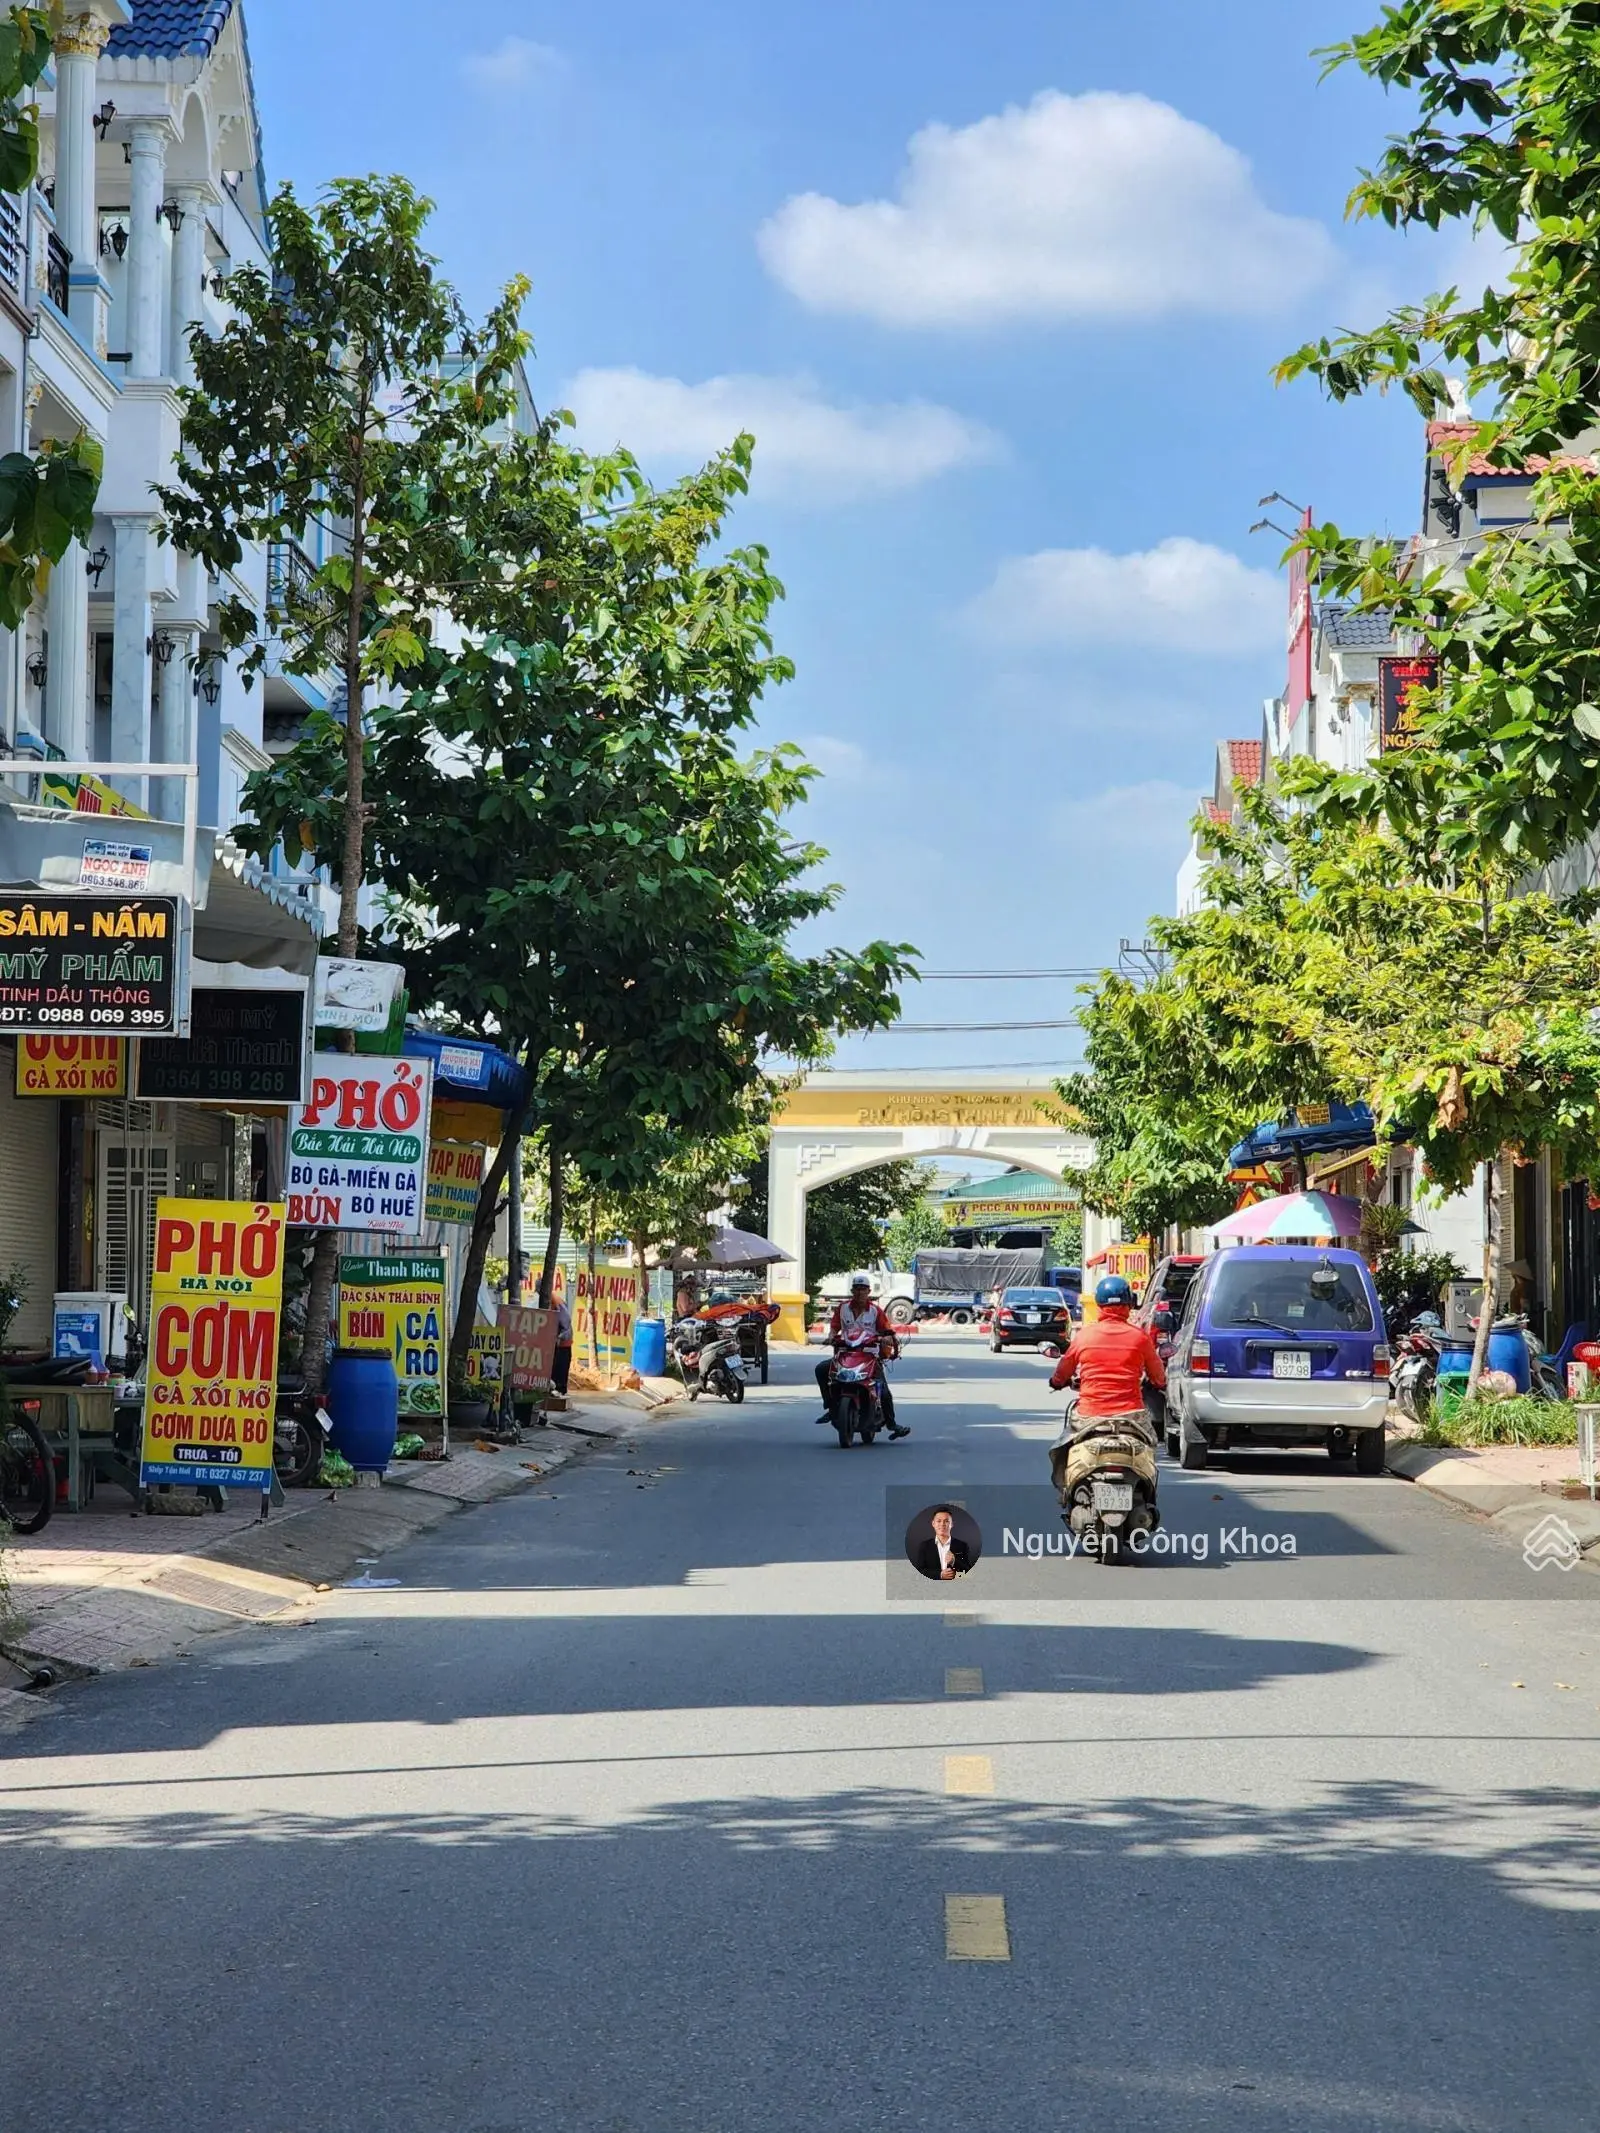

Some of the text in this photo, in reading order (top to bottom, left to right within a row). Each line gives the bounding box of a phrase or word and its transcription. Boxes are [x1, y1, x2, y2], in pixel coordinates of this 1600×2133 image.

[121, 862, 148, 877] ANH
[0, 902, 167, 939] SÂM - NẤM
[0, 941, 164, 982] MỸ PHẨM
[0, 986, 40, 1003] TINH
[89, 985, 152, 1005] THÔNG
[0, 1007, 166, 1025] ĐT: 0988 069 395
[226, 1036, 294, 1066] Thanh
[25, 1060, 118, 1090] GÀ XỐI MỠ
[154, 1068, 286, 1093] 0364 398 268
[300, 1062, 424, 1132] PHỞ
[295, 1132, 323, 1152] Bắc
[291, 1161, 417, 1192] BÒ GÀ-MIẾN GÀ
[430, 1148, 482, 1181] TẠP HÓA
[286, 1187, 417, 1225] BÚN BÒ HUẾ
[972, 1203, 1001, 1212] PCCC
[1004, 1203, 1019, 1212] AN
[156, 1204, 281, 1279] PHỞ
[180, 1275, 253, 1294] HÀ NỘI
[367, 1260, 408, 1278] Thanh
[411, 1262, 441, 1279] Biên
[341, 1290, 363, 1305] ĐẶC
[388, 1289, 413, 1304] THÁI
[415, 1289, 441, 1305] BÌNH
[348, 1306, 385, 1338] BÚN
[406, 1307, 440, 1341] CÁ
[155, 1301, 276, 1382] CƠM
[405, 1343, 439, 1376] RÔ
[1282, 1353, 1302, 1365] 61A
[153, 1380, 271, 1409] GÀ XỐI MỠ
[151, 1411, 268, 1444] CƠM DƯA BÒ
[178, 1447, 208, 1461] TRƯA
[220, 1446, 239, 1463] TỐI
[209, 1468, 230, 1480] 0327
[231, 1470, 247, 1481] 457
[248, 1470, 265, 1482] 237
